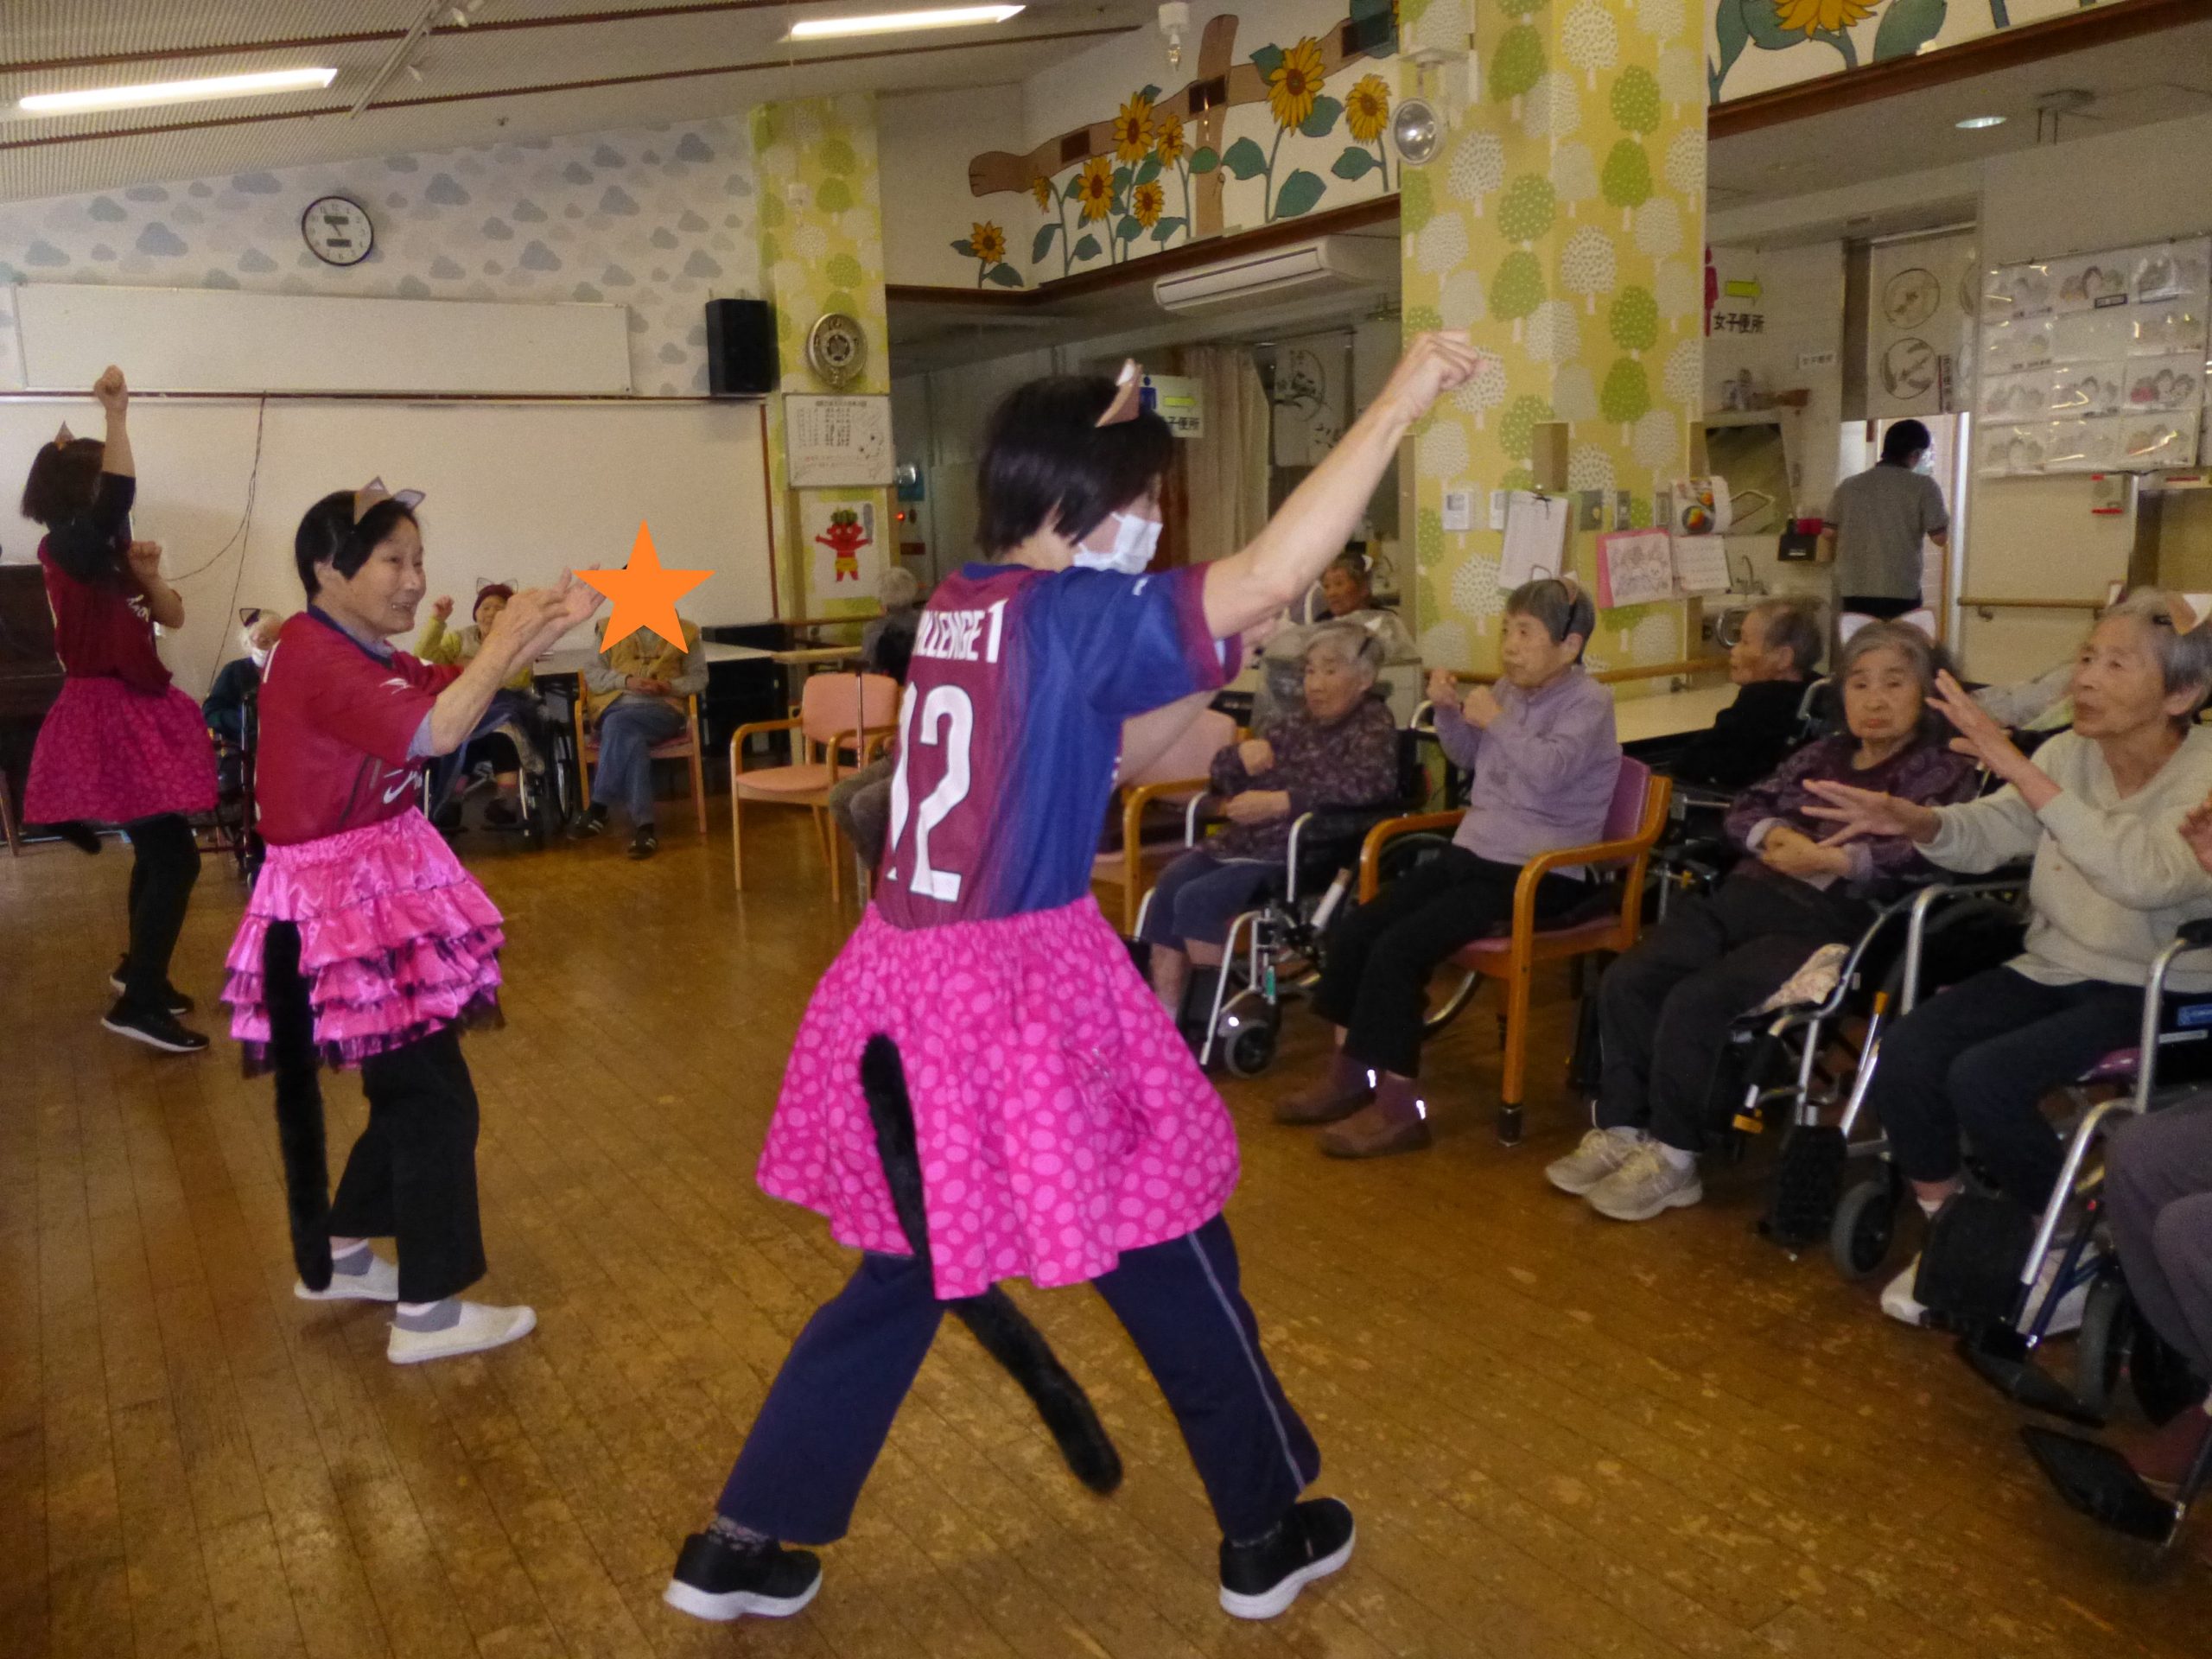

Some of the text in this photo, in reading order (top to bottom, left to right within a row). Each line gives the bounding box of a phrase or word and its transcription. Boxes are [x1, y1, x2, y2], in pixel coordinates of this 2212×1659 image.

[1713, 312, 1764, 334] 女子便所
[986, 598, 1009, 663] 1
